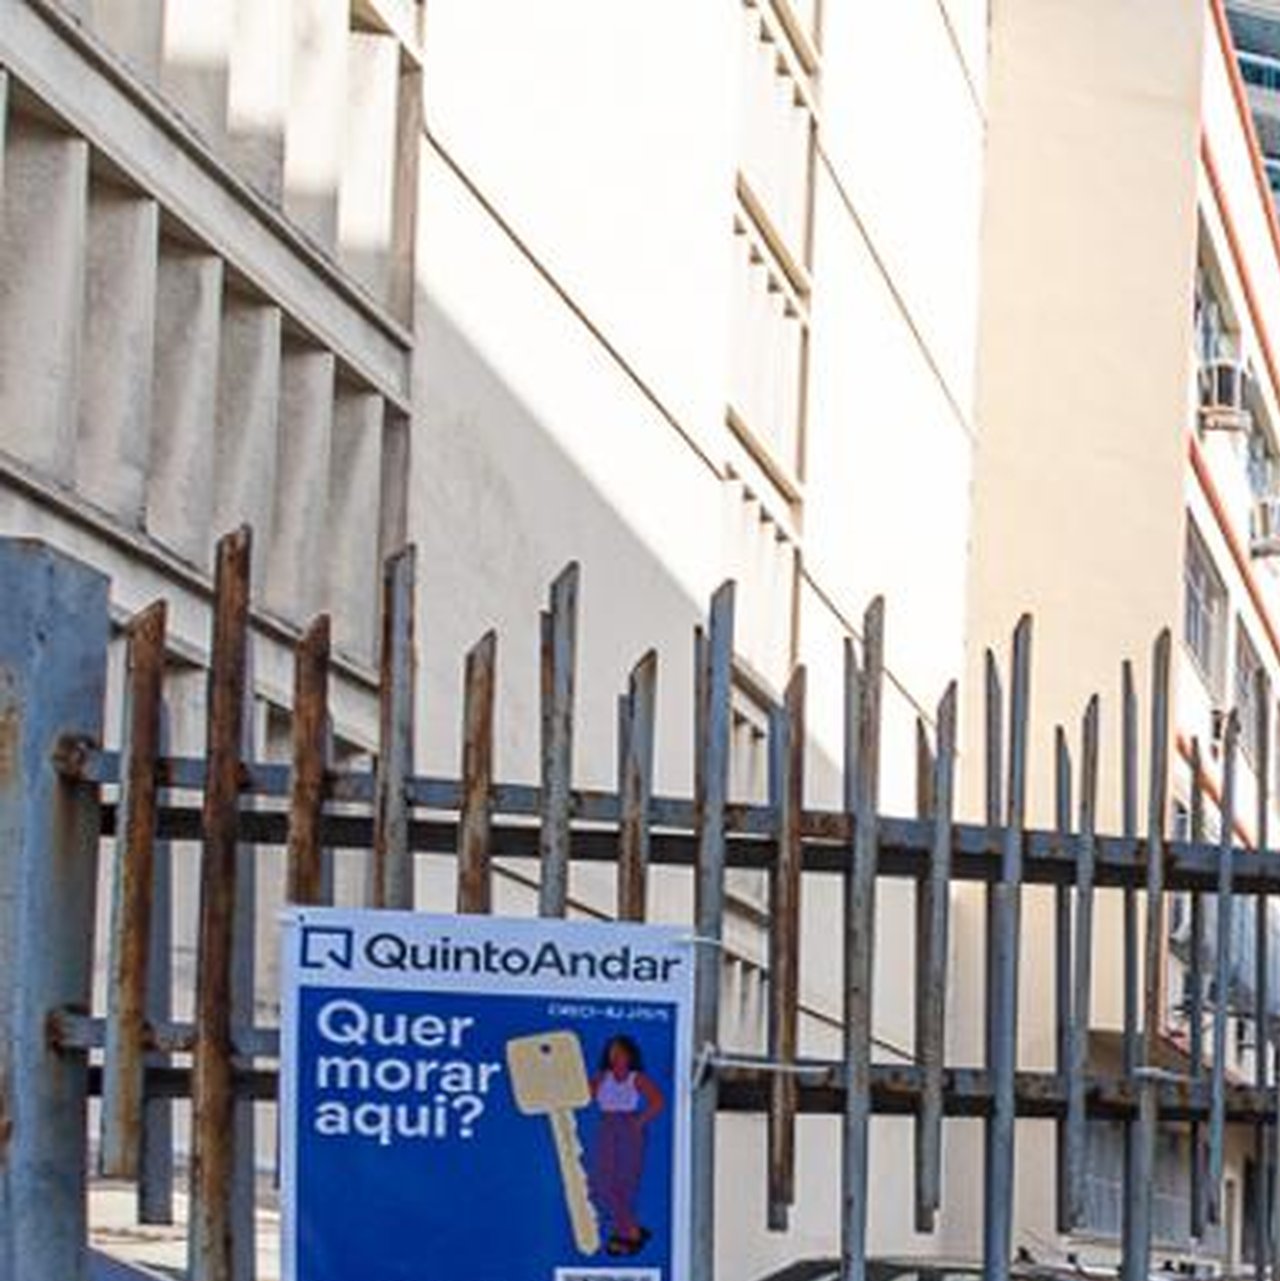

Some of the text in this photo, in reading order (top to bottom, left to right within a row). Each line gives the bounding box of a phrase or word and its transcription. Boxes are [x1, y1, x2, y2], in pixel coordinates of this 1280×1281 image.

[364, 932, 681, 982] QuintoAndar
[317, 999, 475, 1047] Quer
[317, 1055, 502, 1094] morar
[315, 1093, 485, 1146] aqui?
